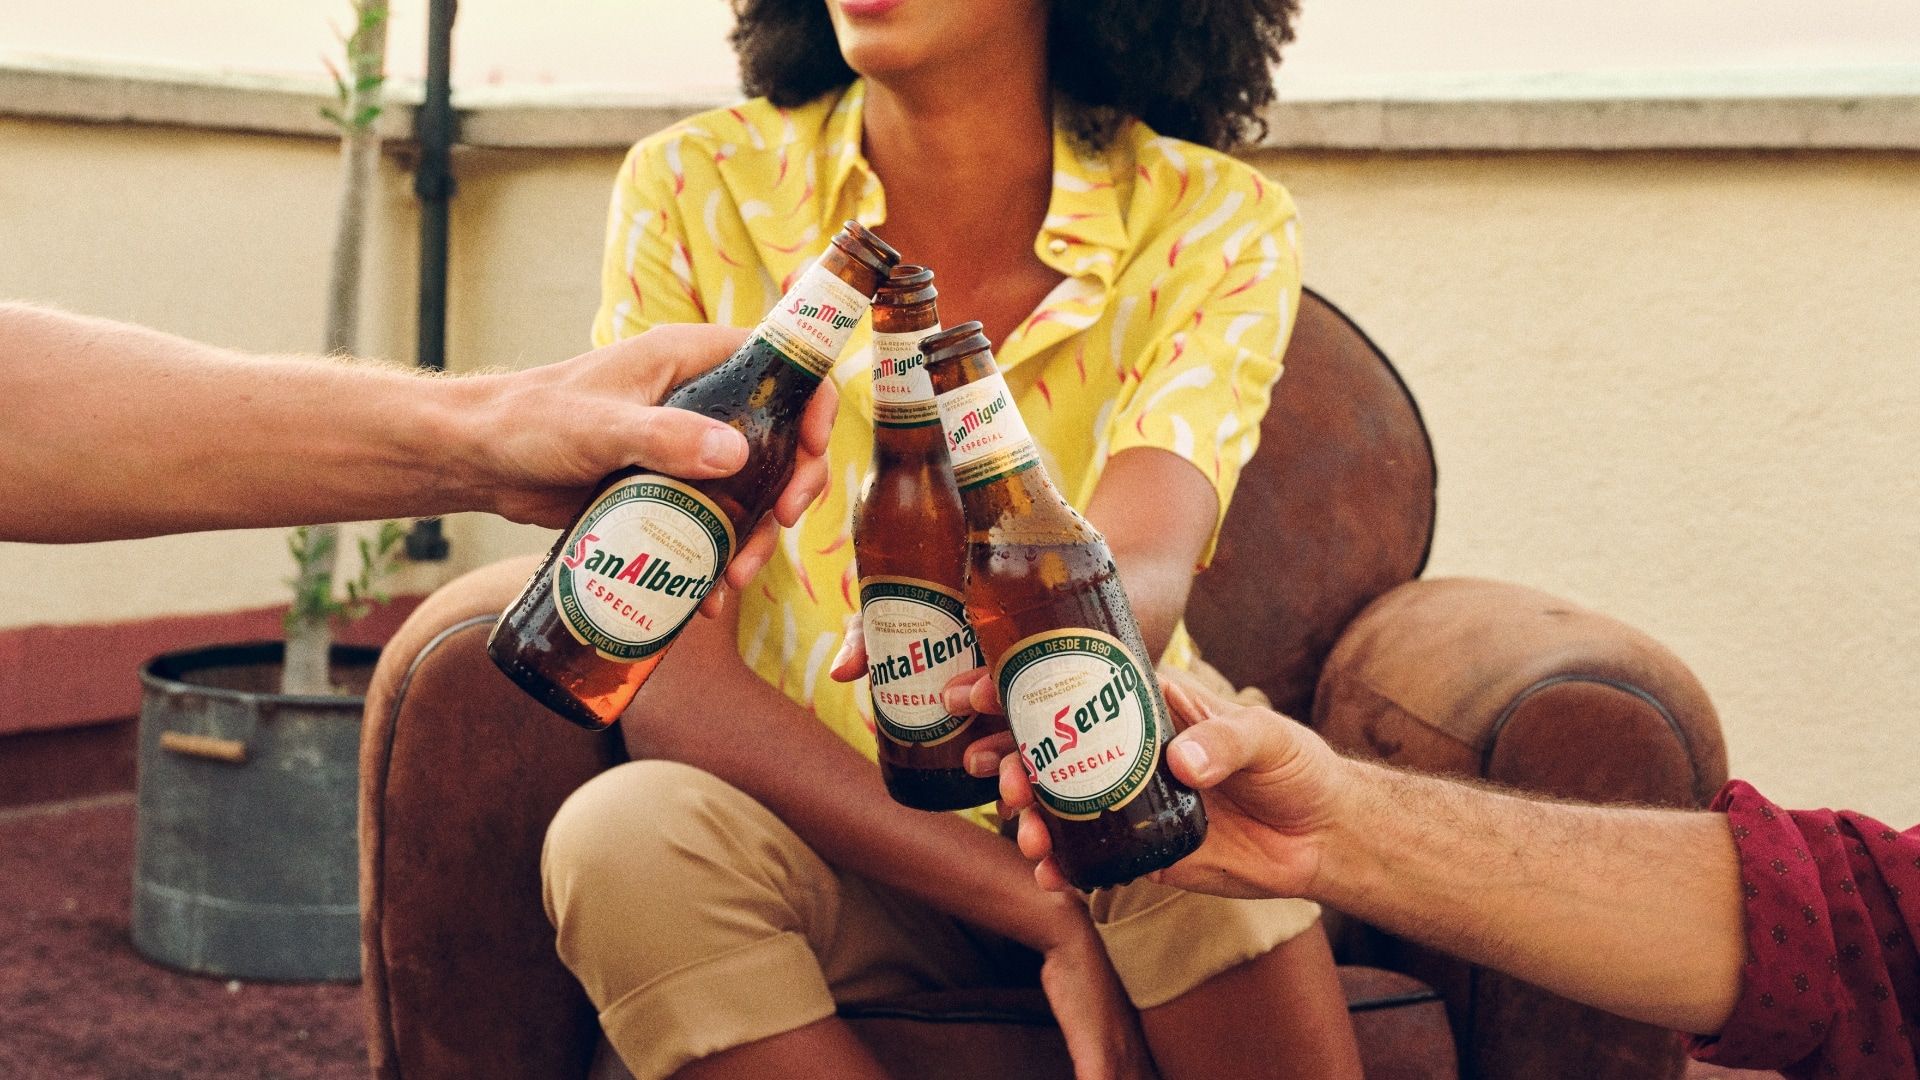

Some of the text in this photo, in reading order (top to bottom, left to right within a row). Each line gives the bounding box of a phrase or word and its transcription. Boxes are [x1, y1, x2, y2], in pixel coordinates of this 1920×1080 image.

[796, 319, 834, 348] ESPECIAL
[872, 353, 923, 384] anMigue
[948, 391, 1007, 451] SanMiguel
[961, 433, 1003, 453] ESPECIAL
[591, 486, 637, 520] TRADICIÓN
[640, 485, 700, 515] CERVECERA
[699, 511, 724, 539] DESDE
[640, 516, 672, 541] CERVEZA
[672, 539, 703, 560] PREMIUM
[640, 524, 694, 564] INTERNACIONAL
[586, 579, 655, 631] ESPECIAL
[900, 586, 931, 600] DESDE
[935, 595, 961, 613] 1890
[563, 594, 627, 656] ORIGINALMENTE
[898, 620, 931, 629] PREMIUM
[870, 624, 976, 687] antaElena
[1045, 638, 1080, 654] DESDE
[1085, 638, 1111, 657] 1890
[1022, 684, 1052, 700] CERVEZA
[1054, 671, 1089, 689] PREMIUM
[1028, 681, 1087, 705] INTERNACIONAL
[1051, 745, 1125, 784] ESPECIAL
[1054, 783, 1132, 813] ORIGINALMENTE
[1131, 736, 1155, 785] NATURAL
